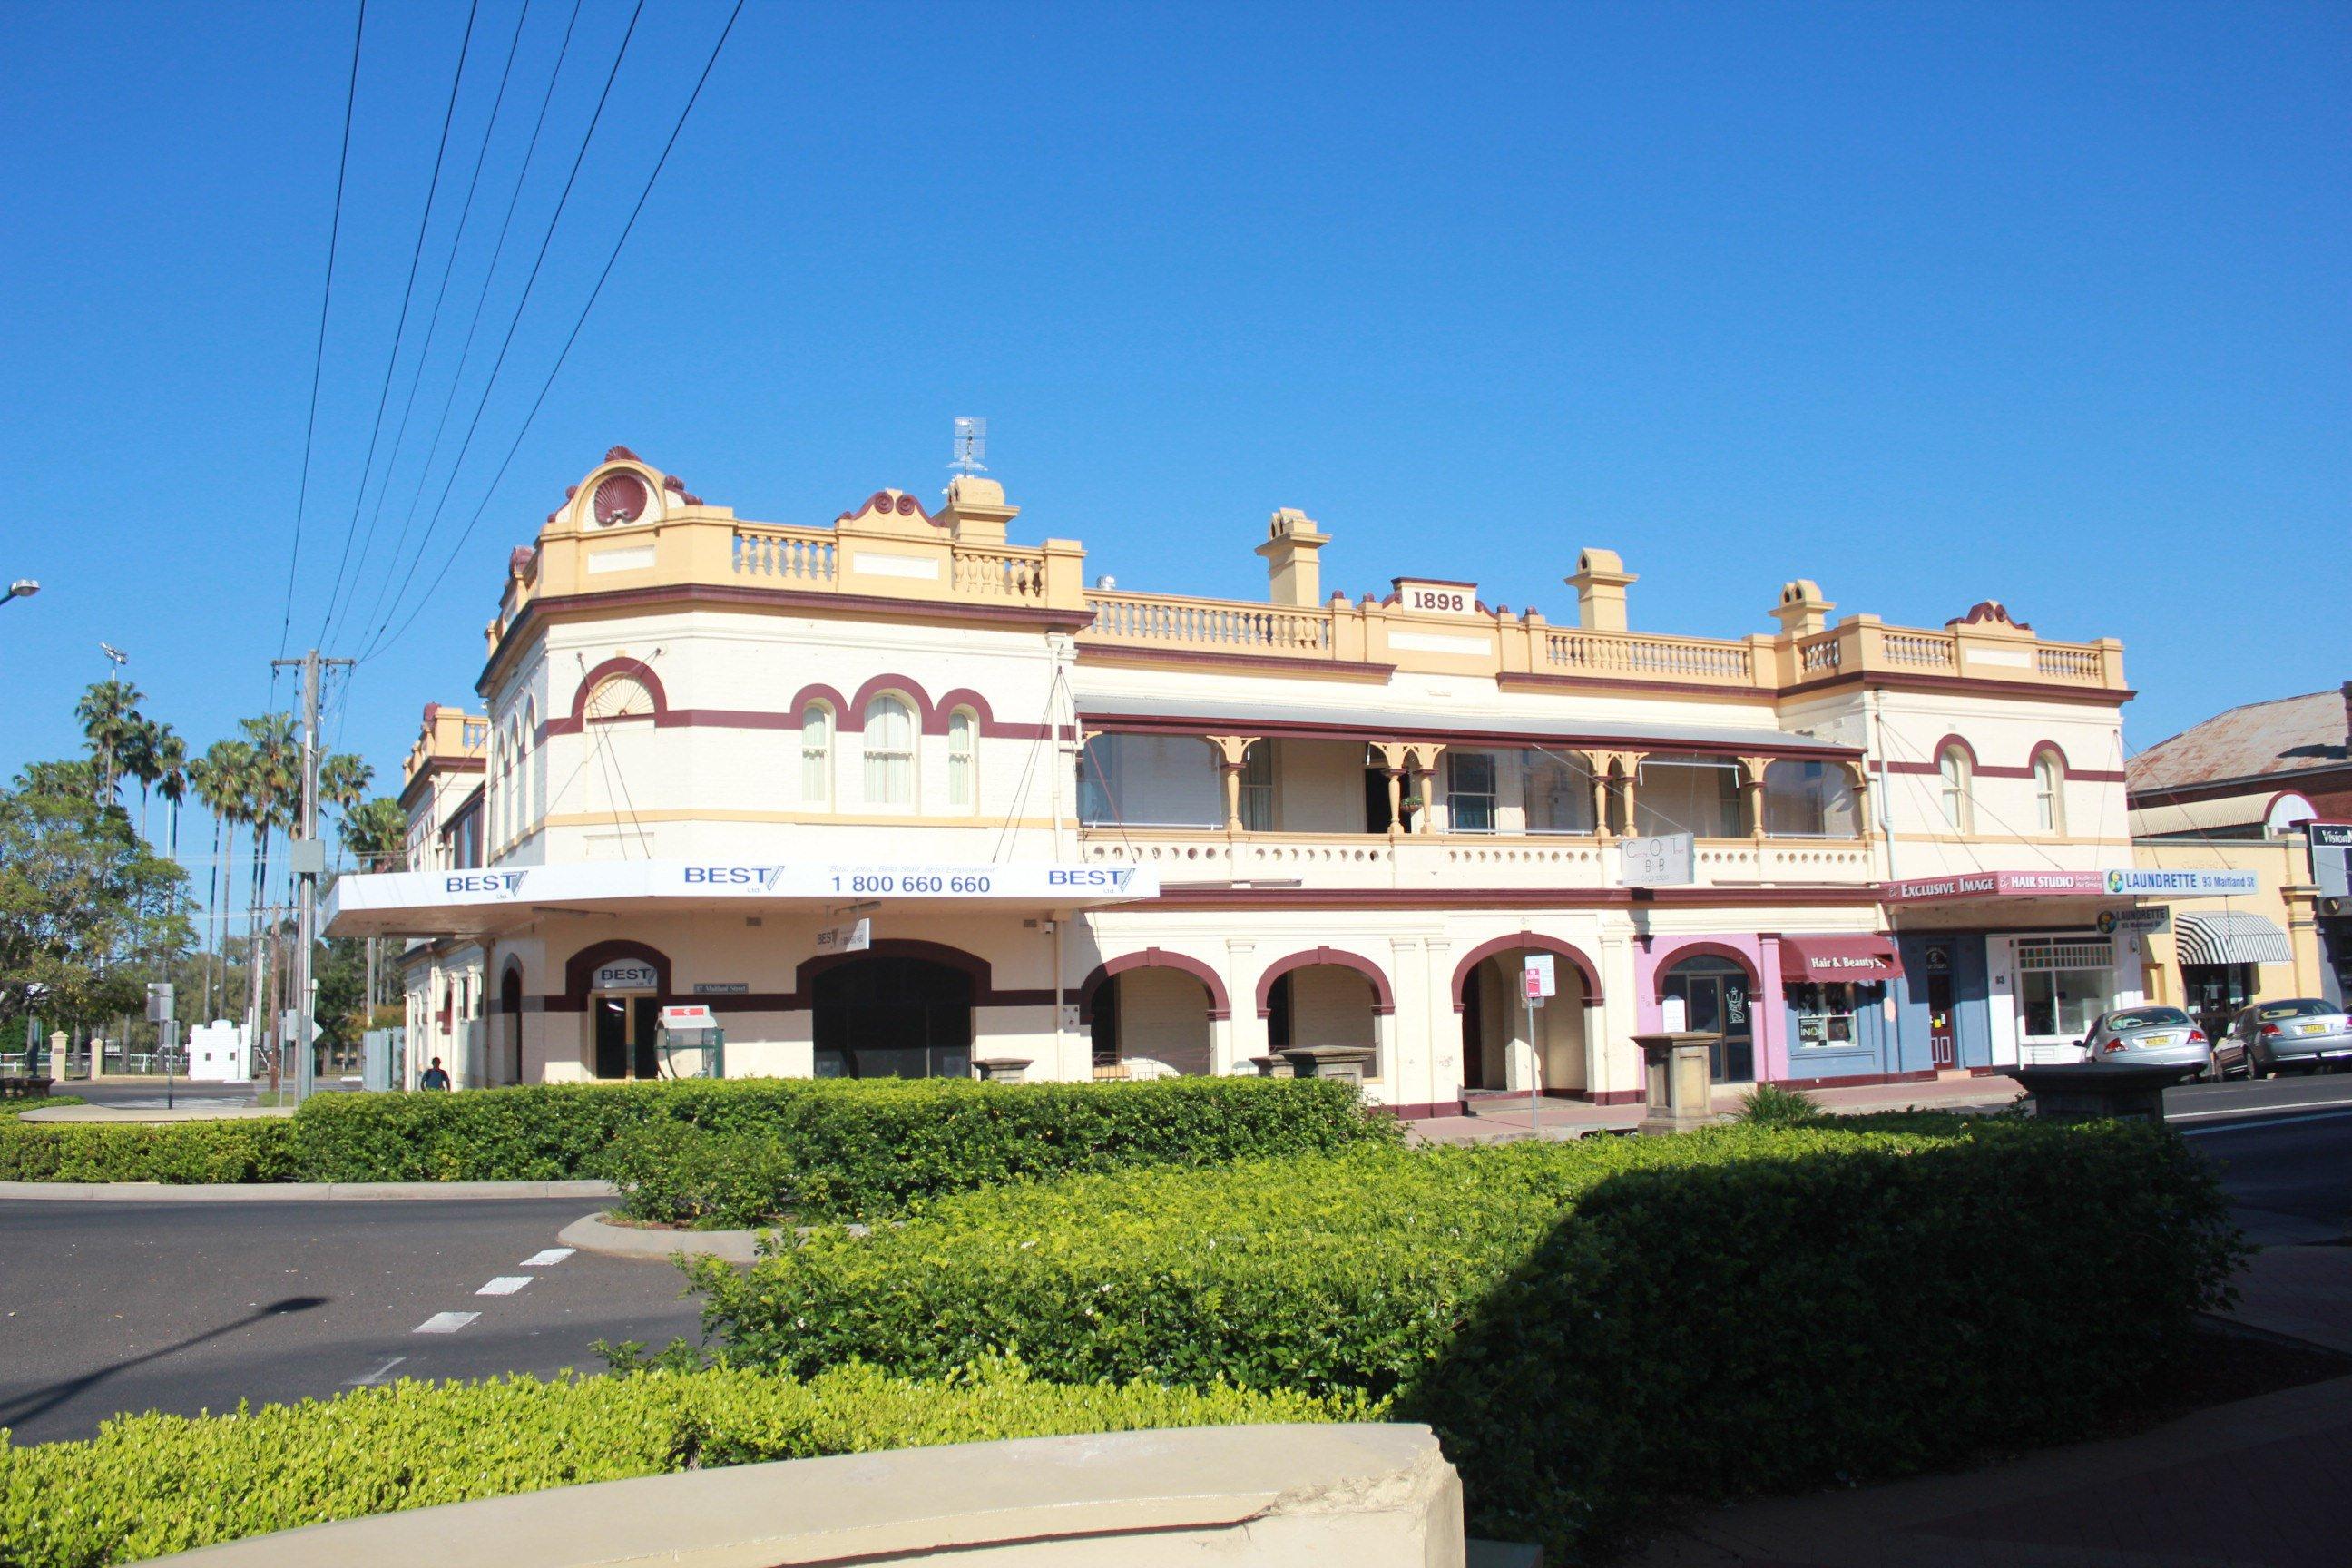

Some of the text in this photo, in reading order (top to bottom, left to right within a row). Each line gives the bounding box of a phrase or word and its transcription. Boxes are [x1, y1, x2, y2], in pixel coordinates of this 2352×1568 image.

[1415, 592, 1463, 611] 1898
[684, 867, 771, 884] BEST
[1048, 870, 1124, 885] BEST
[2011, 876, 2037, 888] HAIR
[2038, 876, 2075, 888] STUDIO
[2125, 873, 2255, 888] LAUNDRETTE 93 Maitland St
[446, 874, 518, 893] BEST
[832, 875, 991, 893] 1 800 660 660
[1901, 882, 1955, 897] EXCLUSIVE
[1958, 878, 1994, 893] IMAGE
[2116, 909, 2165, 921] LAUNDRETTE
[1811, 957, 1830, 968] Hair
[1832, 957, 1842, 967] &
[1842, 957, 1874, 969] Beauty
[601, 968, 651, 981] BEST
